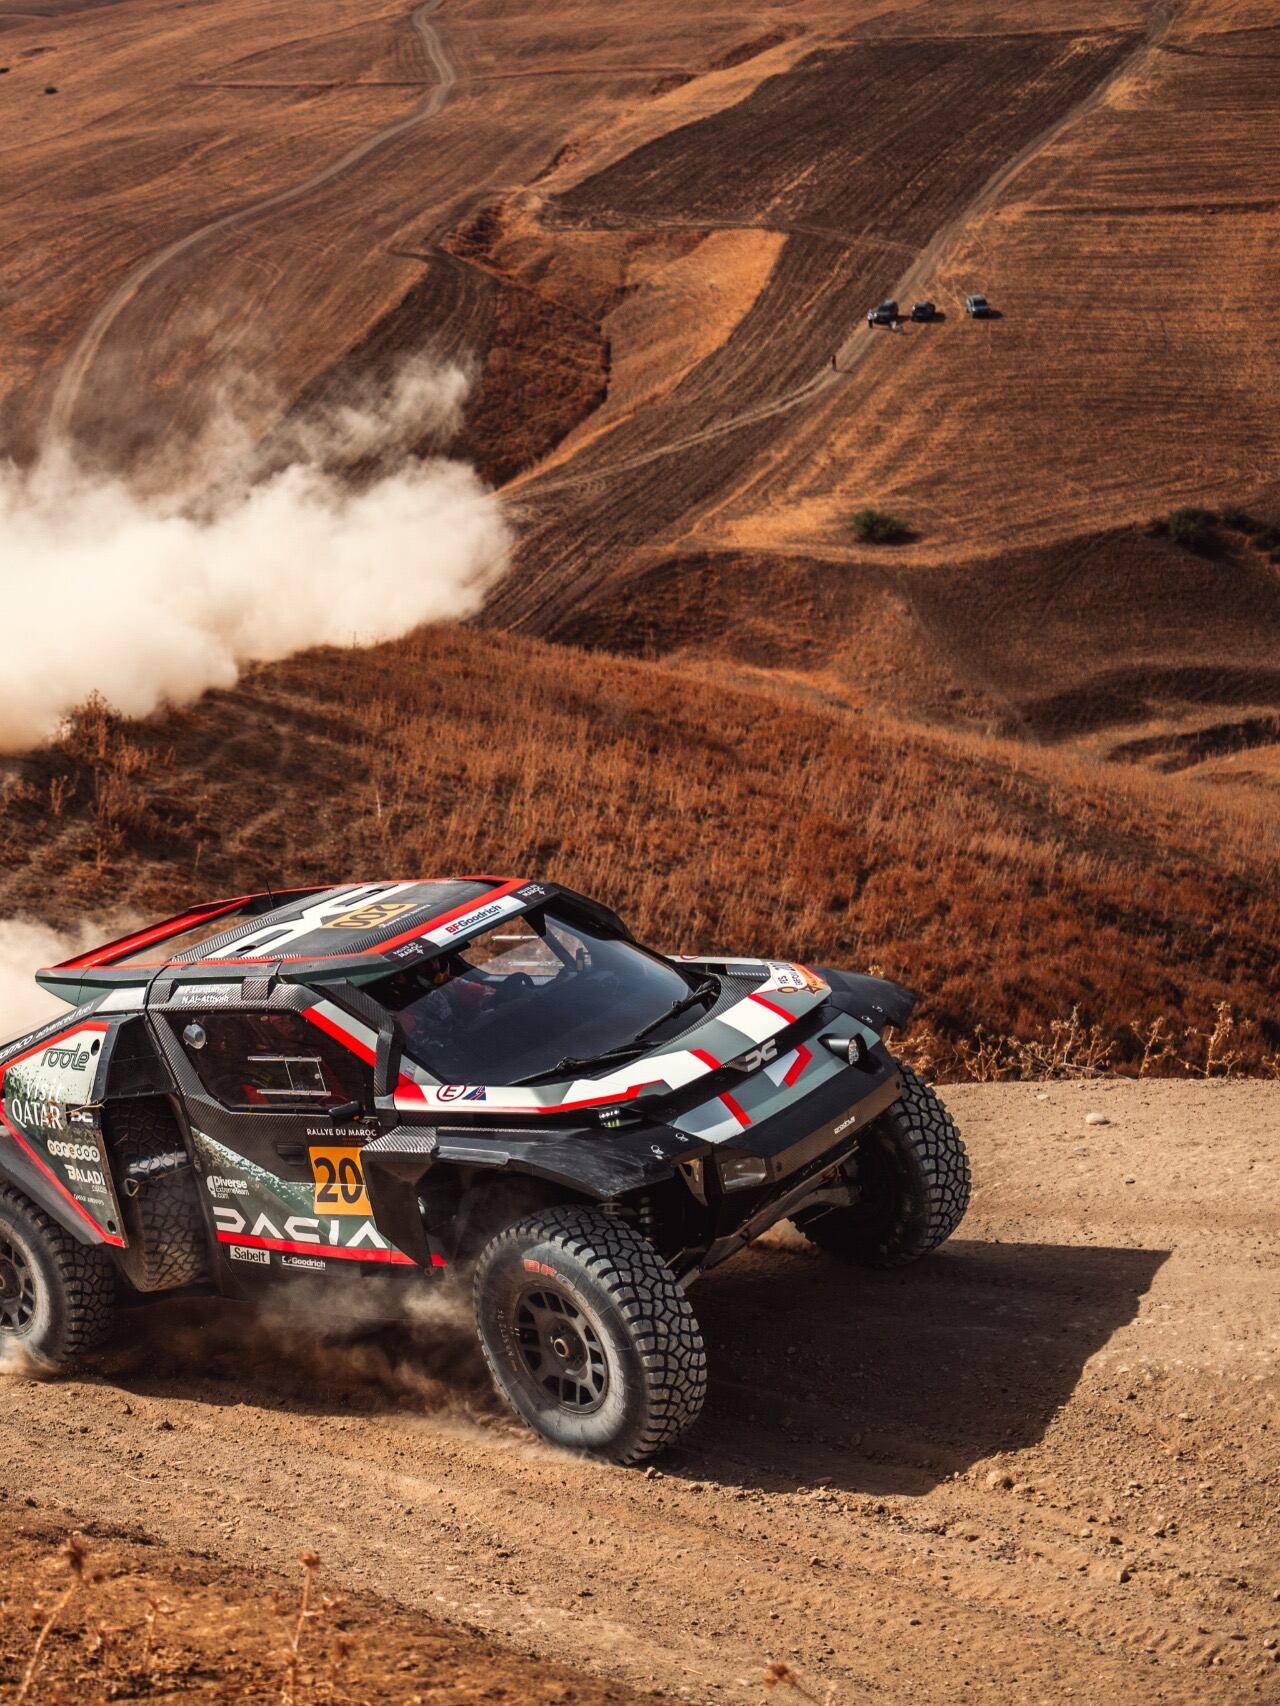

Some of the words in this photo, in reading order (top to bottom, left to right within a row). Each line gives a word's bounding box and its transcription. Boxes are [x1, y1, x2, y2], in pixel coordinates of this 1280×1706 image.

[445, 905, 502, 933] BFGoodrich
[12, 1099, 63, 1131] QATAR
[306, 1128, 334, 1136] RALLYE
[335, 1128, 347, 1136] DU
[348, 1128, 377, 1137] MAROC
[47, 1140, 100, 1162] ooredoo
[64, 1164, 106, 1186] BALADI
[213, 1176, 248, 1189] Diverse
[213, 1206, 388, 1249] DACIA
[234, 1247, 267, 1263] Sabelt
